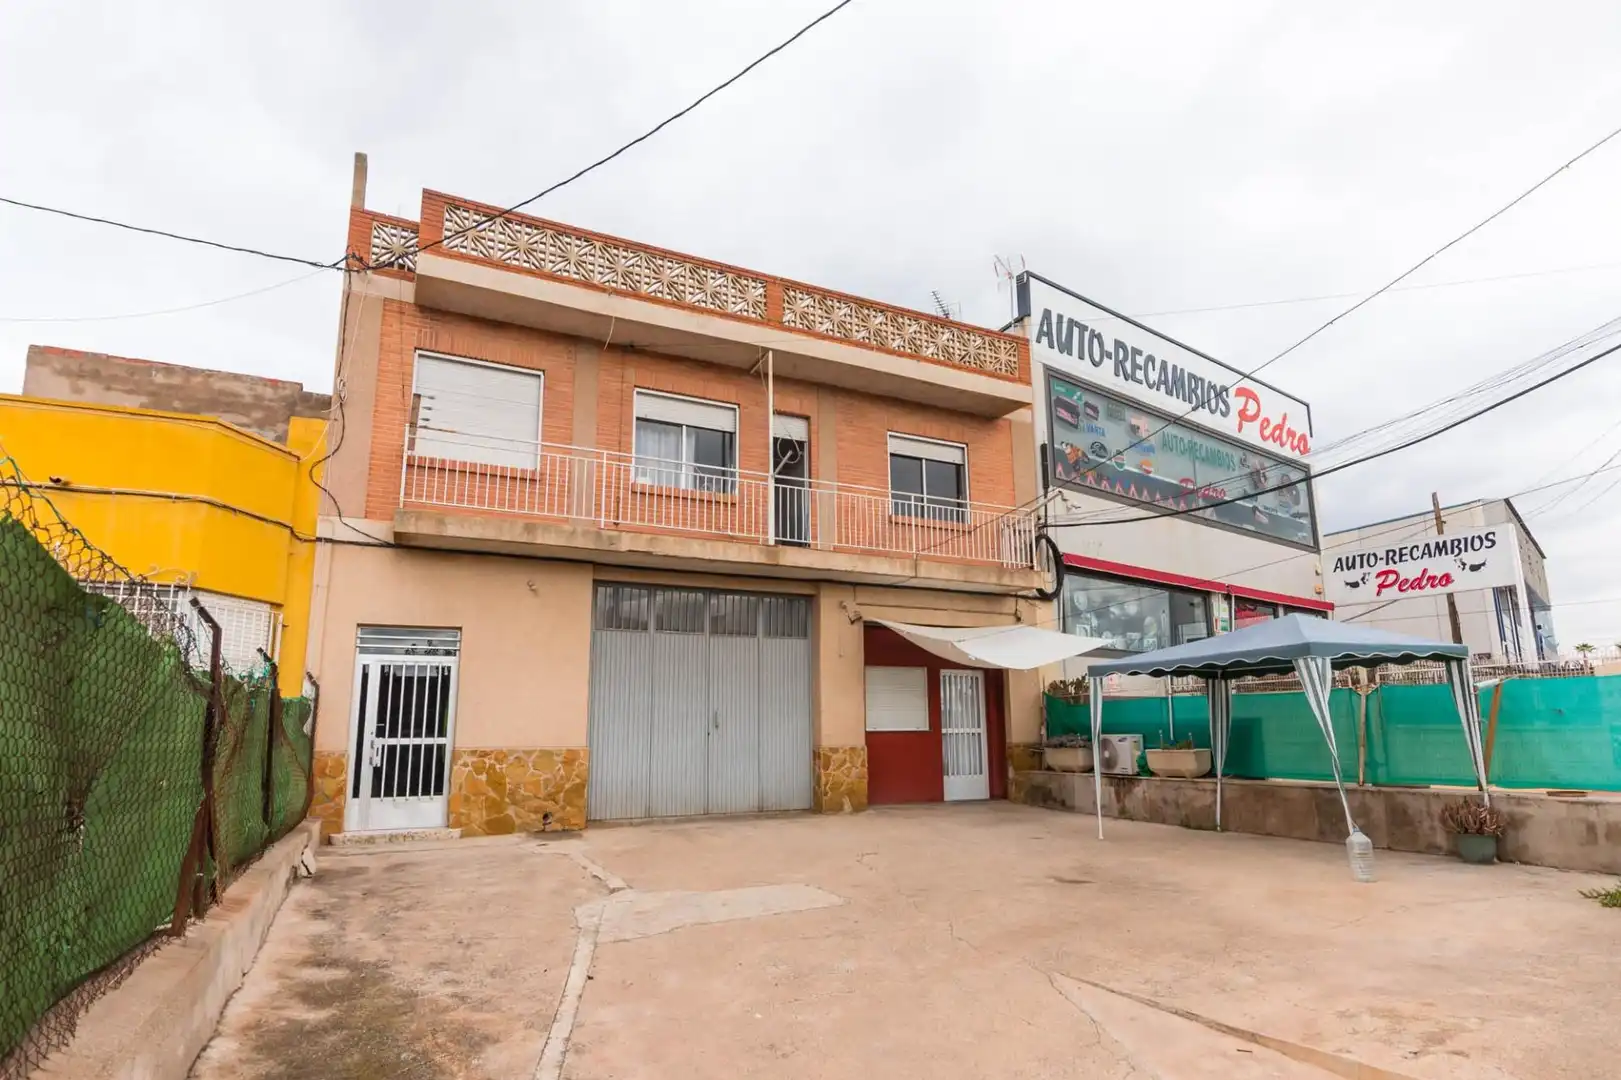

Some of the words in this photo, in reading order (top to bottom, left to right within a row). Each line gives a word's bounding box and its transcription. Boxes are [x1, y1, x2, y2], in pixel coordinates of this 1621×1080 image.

[1035, 307, 1231, 418] AUTO-RECAMBIOS
[1234, 386, 1311, 456] Pedro
[1162, 430, 1236, 472] AUTO-RECAMBIOS
[1333, 531, 1497, 573] AUTO-RECAMBIOS
[1375, 568, 1455, 597] Pedro
